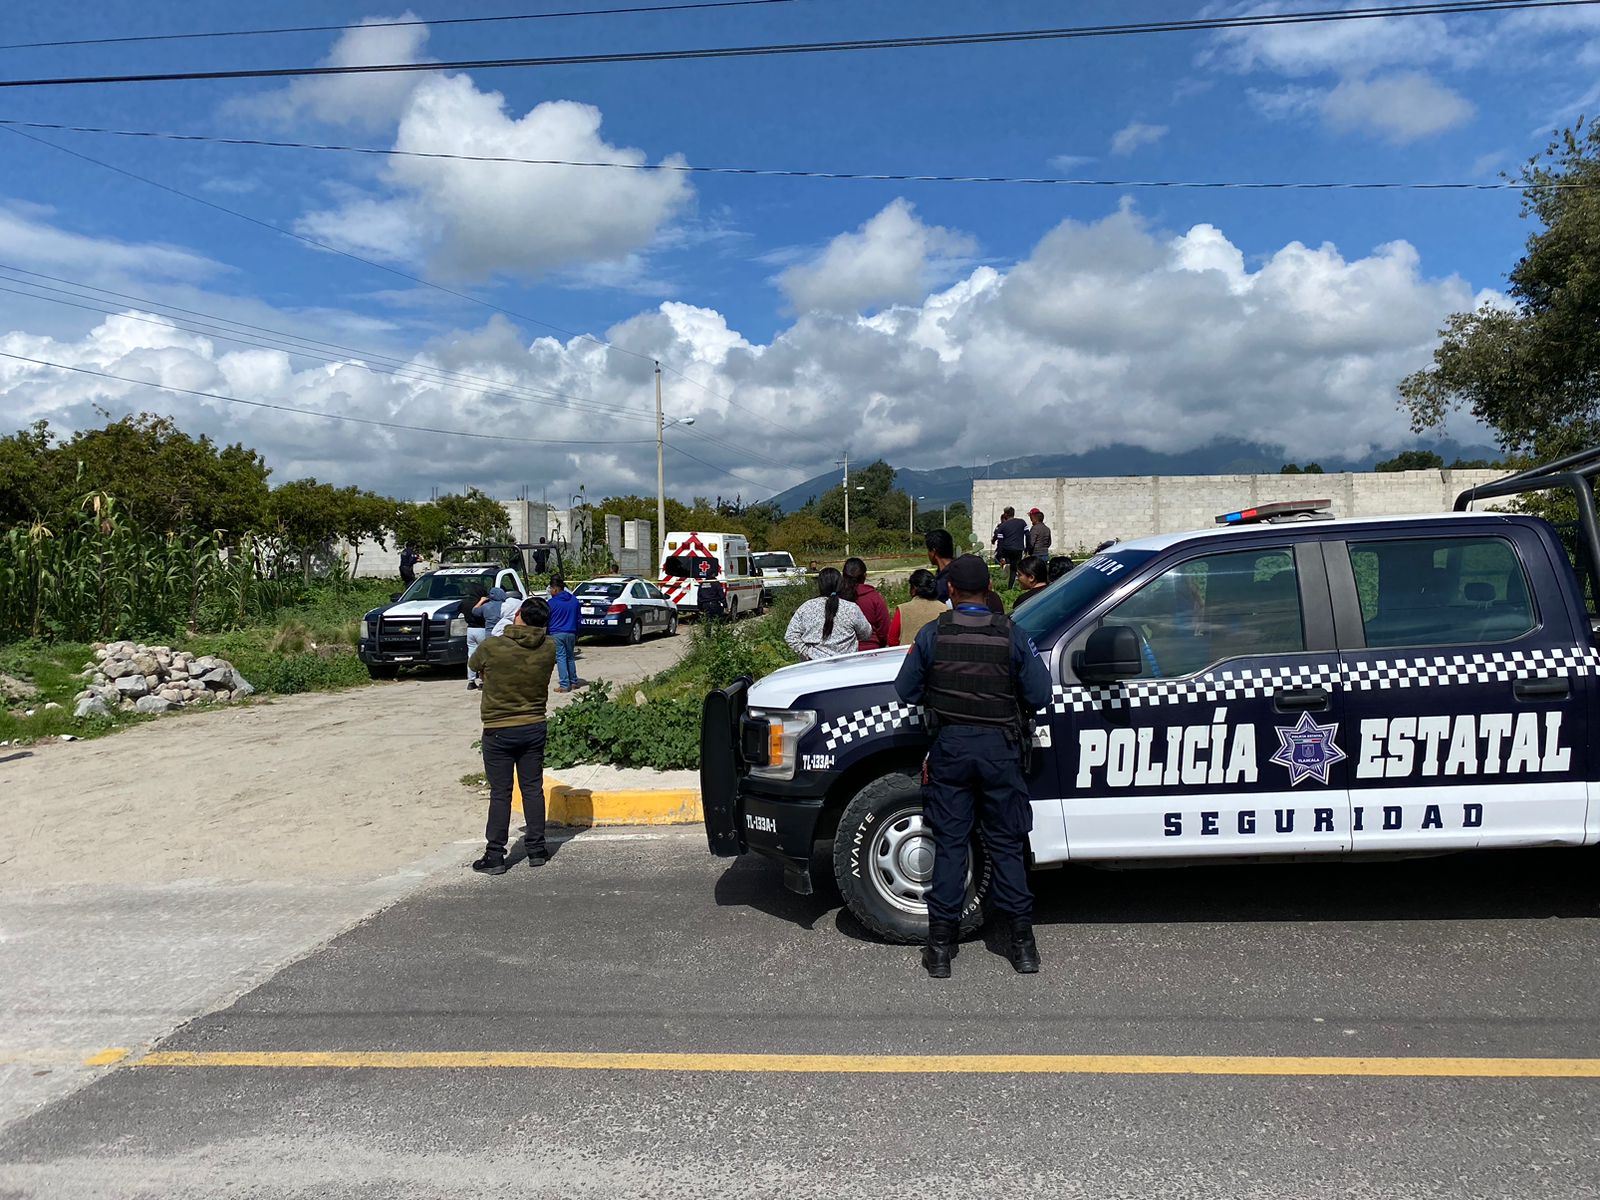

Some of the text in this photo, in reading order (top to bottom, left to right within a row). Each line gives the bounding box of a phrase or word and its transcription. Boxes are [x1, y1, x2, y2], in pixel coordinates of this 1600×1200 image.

[802, 754, 835, 770] TL-133A-1
[1076, 707, 1572, 788] POLICÍA ESTATAL
[746, 814, 777, 833] TL-133A-1
[1164, 803, 1483, 836] SEGURIDAD
[850, 812, 875, 878] AVANTE
